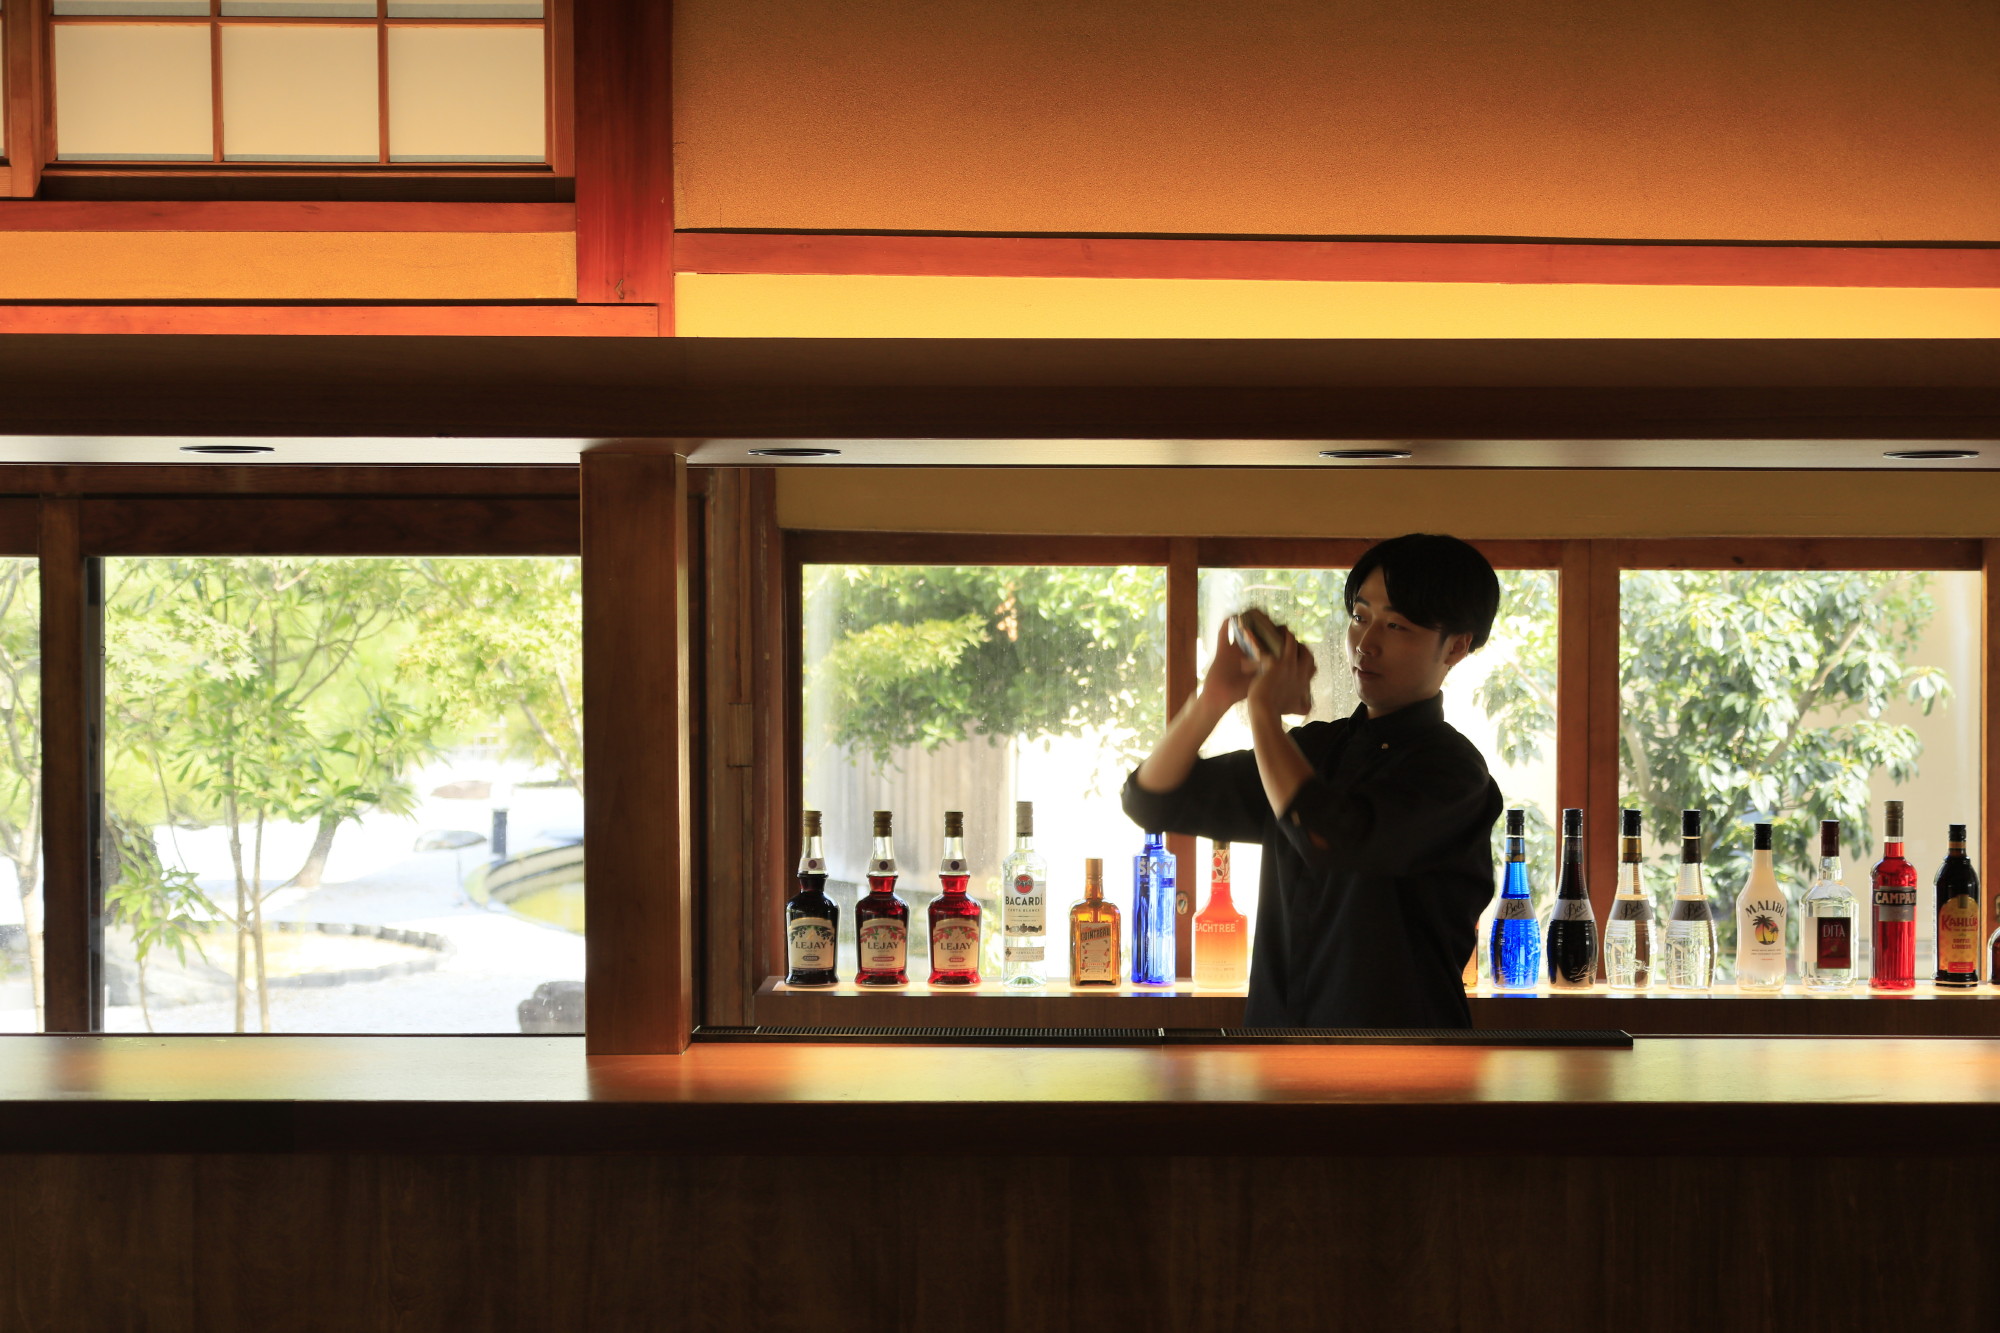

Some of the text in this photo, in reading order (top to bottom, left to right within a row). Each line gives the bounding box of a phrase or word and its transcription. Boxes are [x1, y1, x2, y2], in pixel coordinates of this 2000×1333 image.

[1138, 860, 1172, 876] SKYY
[1875, 891, 1917, 904] CAMPAR
[1502, 900, 1525, 916] Bols
[1745, 899, 1785, 917] MALIBU
[1081, 927, 1110, 941] COINTREAU
[1195, 922, 1236, 933] EACHTREE
[1823, 924, 1846, 938] DITA
[795, 941, 827, 949] LEJAY
[867, 941, 899, 950] LEJAY
[940, 942, 972, 951] LEJAY
